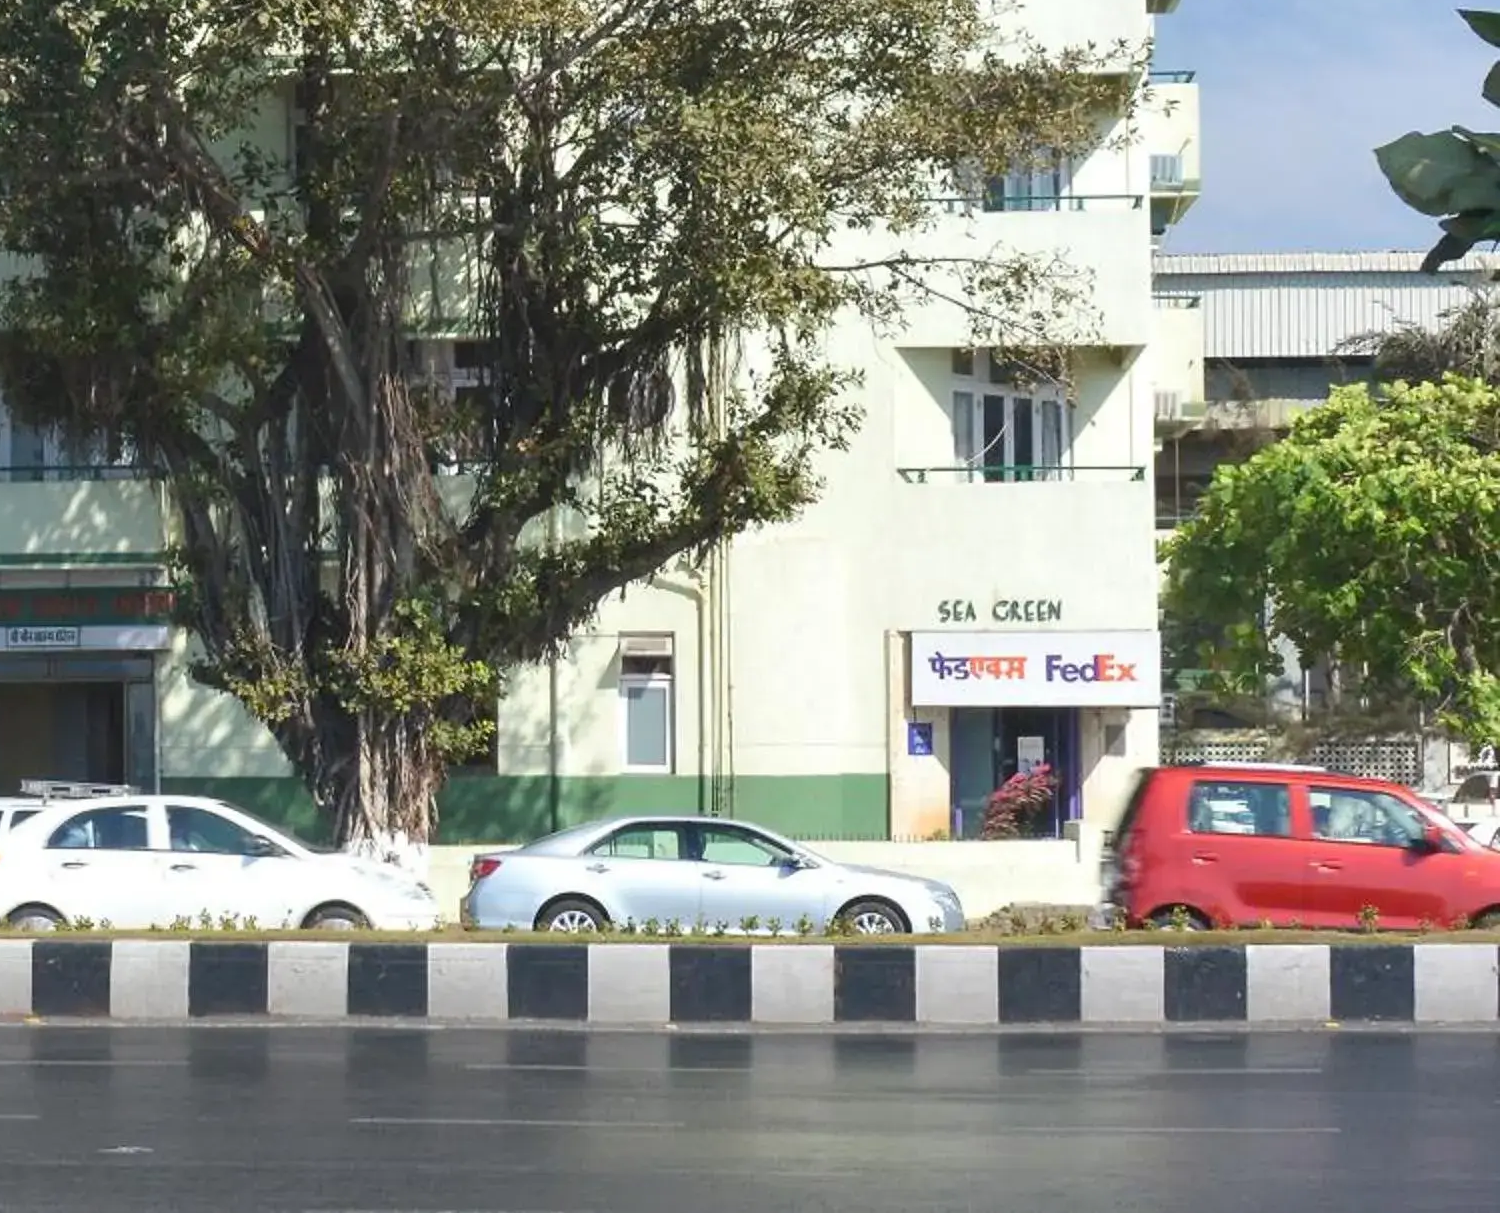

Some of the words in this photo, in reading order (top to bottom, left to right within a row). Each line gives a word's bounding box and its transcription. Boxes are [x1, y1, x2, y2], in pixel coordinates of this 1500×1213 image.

[937, 600, 977, 623] SEA
[992, 600, 1062, 622] GREEN
[1045, 654, 1138, 682] FedEx
